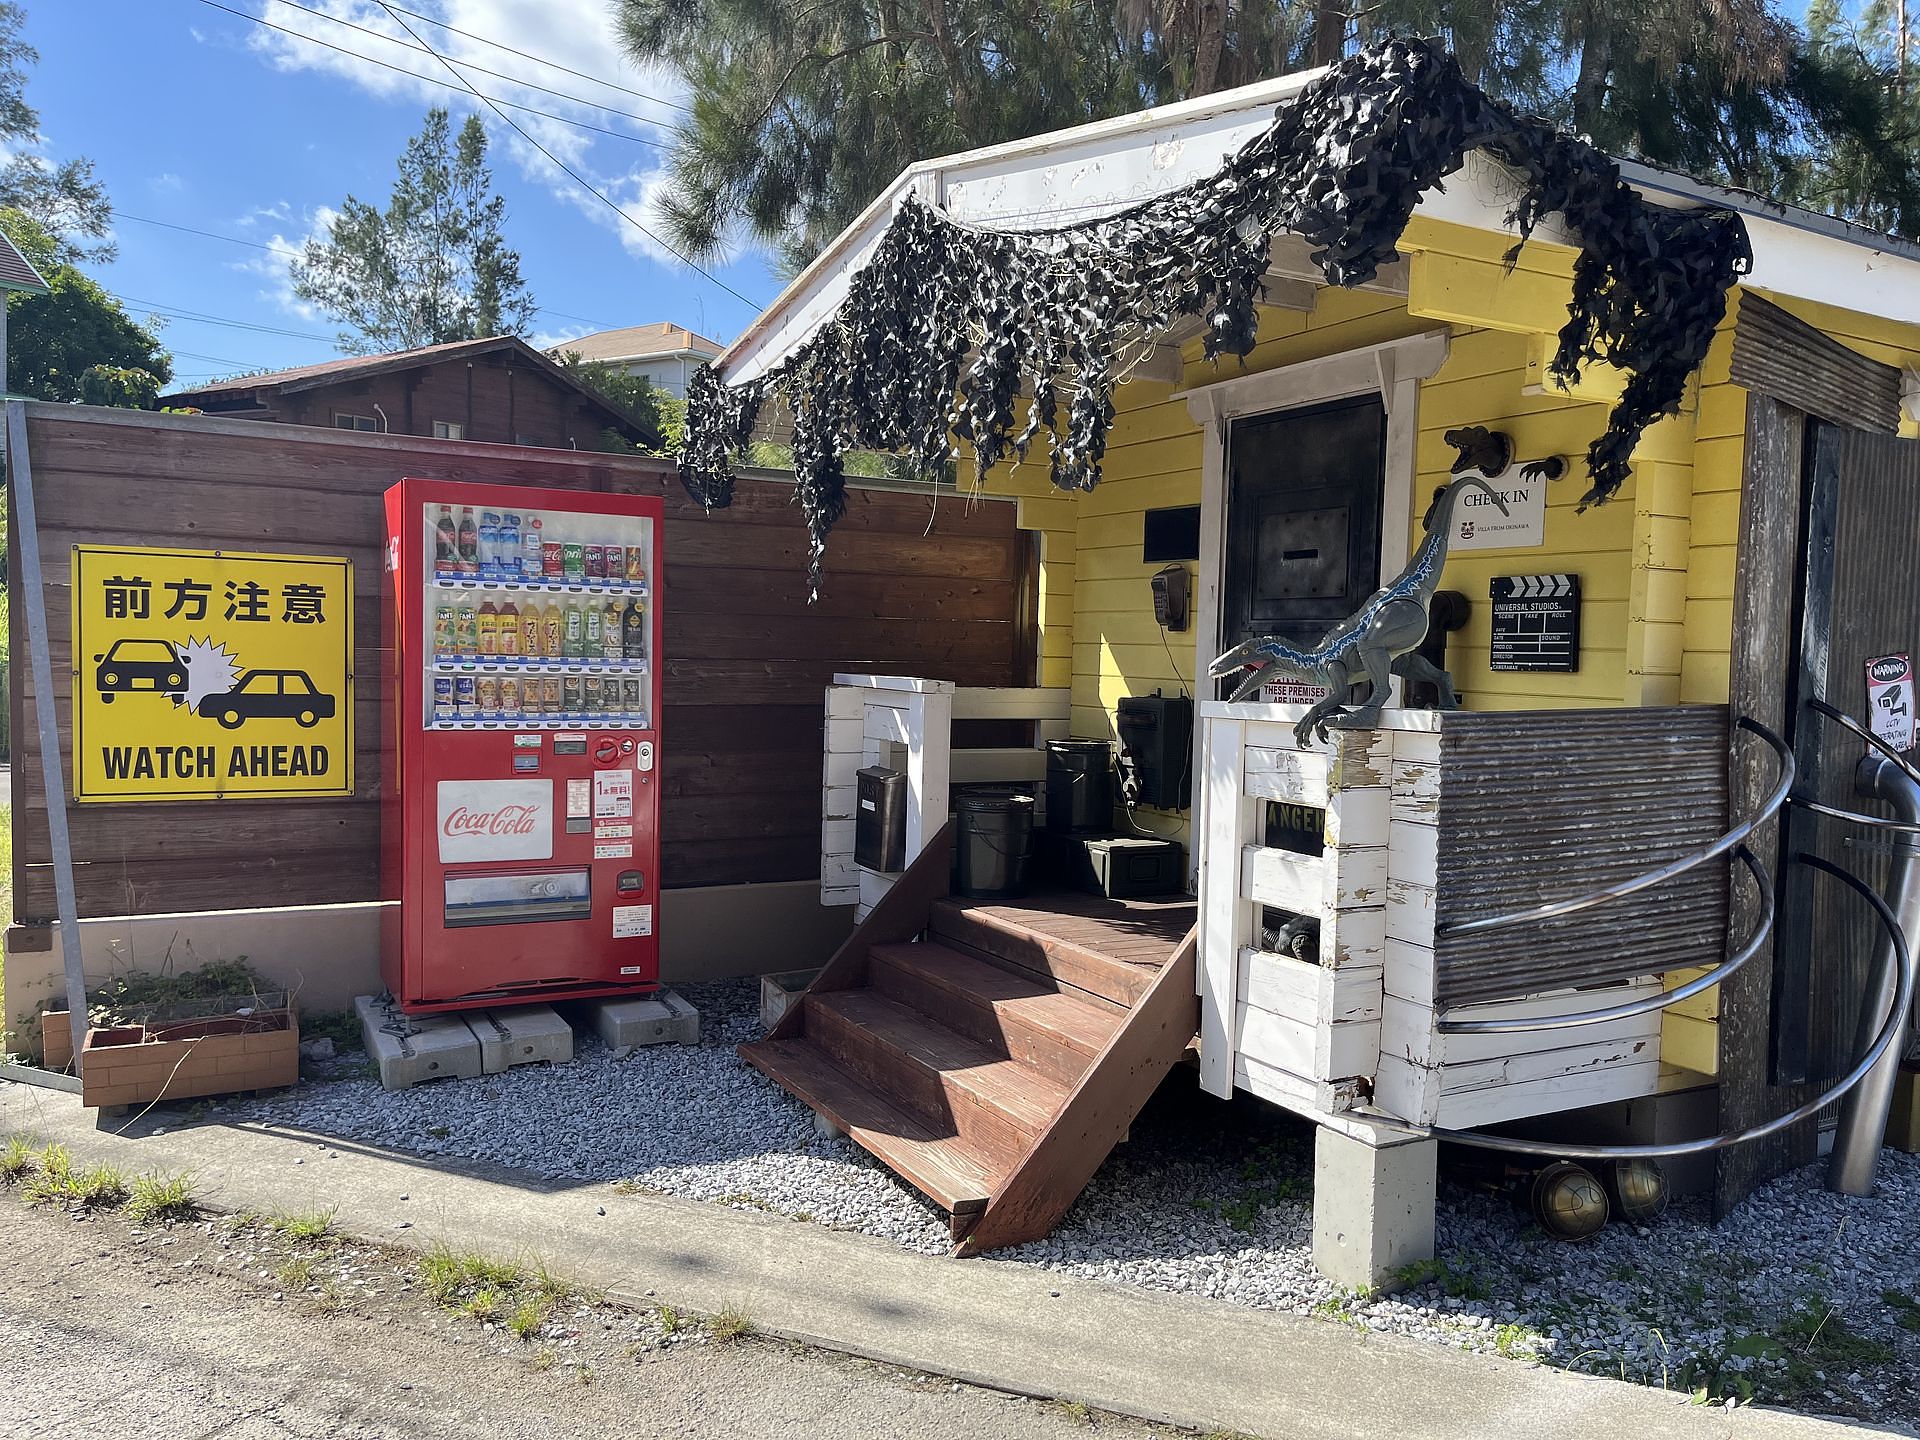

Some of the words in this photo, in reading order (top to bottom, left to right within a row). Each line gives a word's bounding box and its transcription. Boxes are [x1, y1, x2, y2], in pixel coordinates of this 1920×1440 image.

[1513, 489, 1529, 503] IN
[102, 575, 327, 624] 前方注意
[1494, 603, 1529, 612] UNIVERSAL
[1530, 602, 1559, 610] STUDIOS
[1873, 663, 1904, 677] WARNING
[1264, 685, 1287, 696] THESE
[1288, 686, 1325, 698] PREMISES
[1886, 718, 1900, 728] CCTV
[1878, 731, 1907, 741] PERATING
[102, 746, 216, 780] WATCH
[227, 745, 330, 778] AHEAD
[443, 805, 541, 837] Coca-Cola
